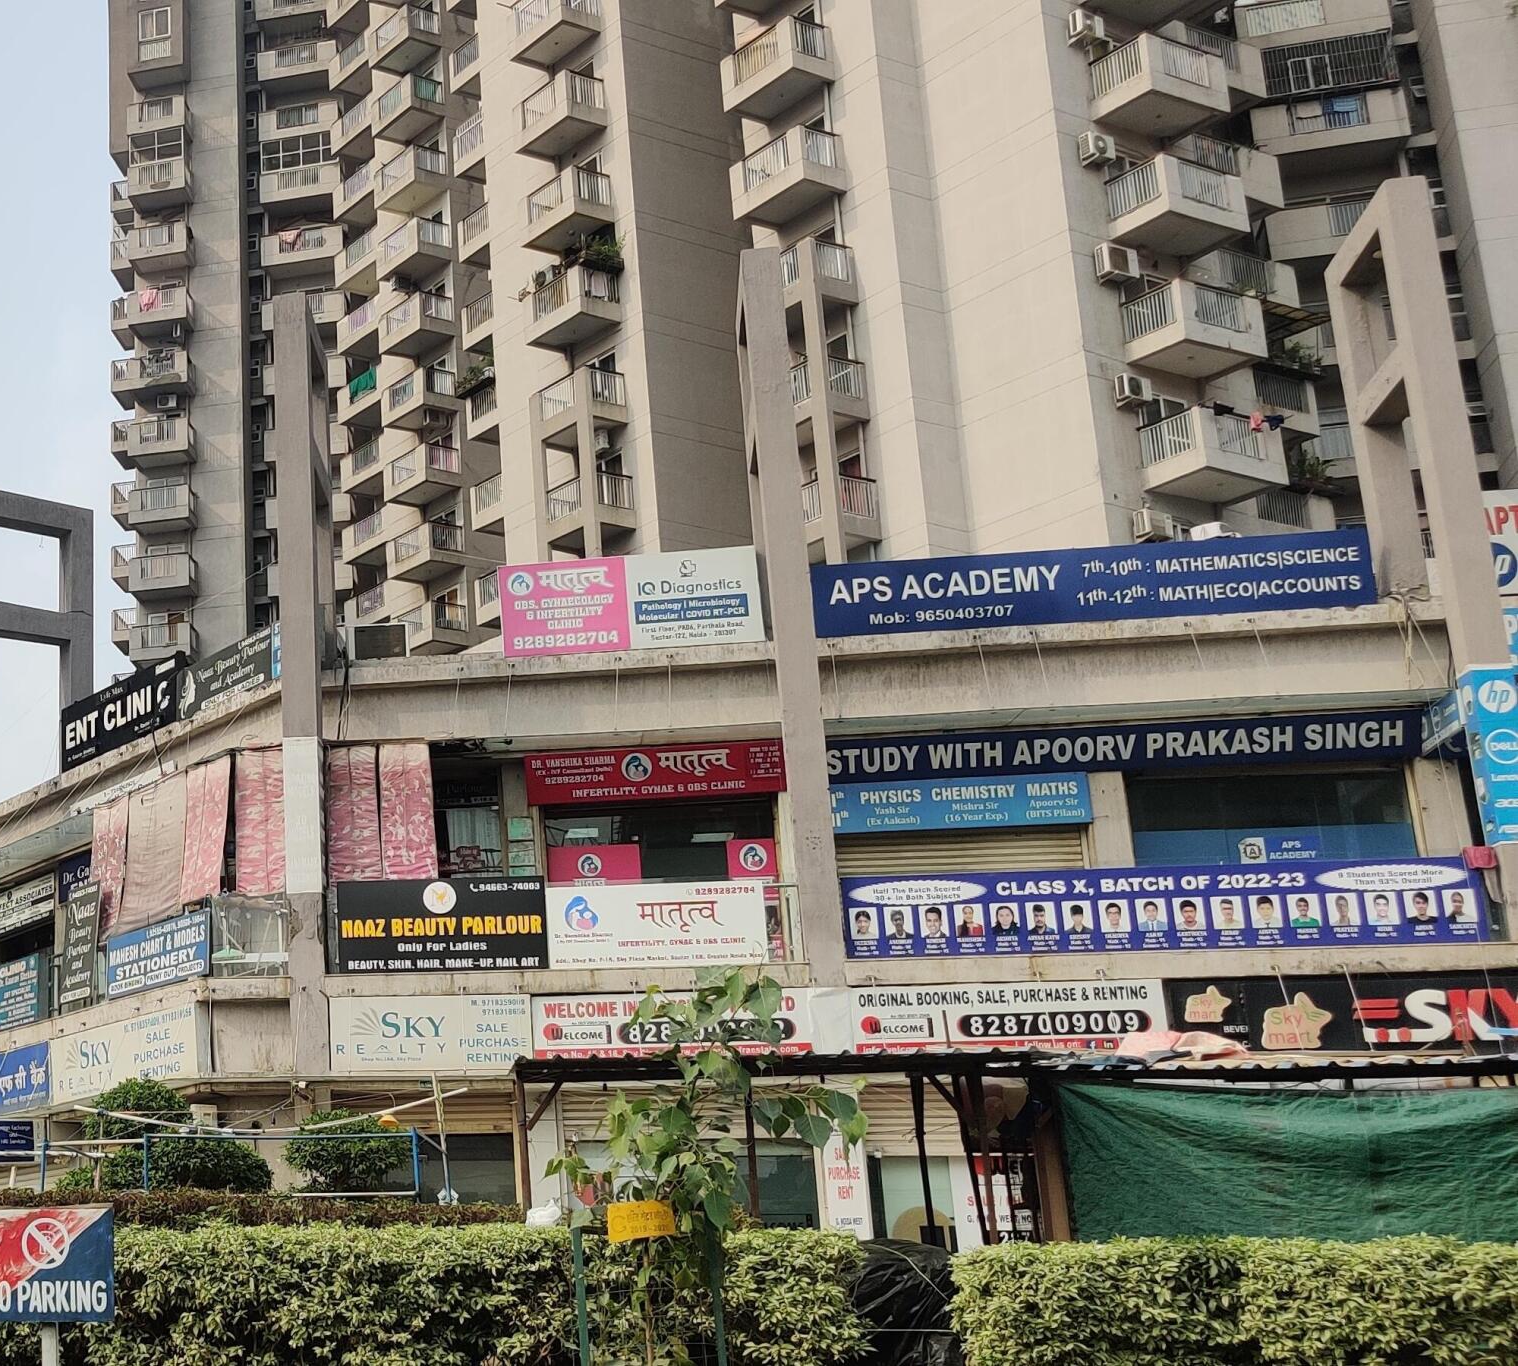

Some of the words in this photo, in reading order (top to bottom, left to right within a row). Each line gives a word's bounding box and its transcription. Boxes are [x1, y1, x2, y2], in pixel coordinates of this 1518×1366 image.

[638, 582, 656, 596] IQ
[661, 579, 742, 594] Diagnostics
[830, 575, 892, 605] APS
[901, 565, 1060, 600] ACADEMY
[642, 603, 682, 611] Pathology
[689, 598, 740, 608] Microbiology
[639, 613, 679, 621] Molecular
[686, 609, 711, 618] COVID
[713, 607, 745, 616] RT-PCR
[869, 612, 910, 625] Mob:
[916, 605, 1014, 622] 9650403707
[514, 630, 619, 649] 9289282704
[66, 710, 98, 750] ENT
[827, 745, 919, 775] STUDY
[928, 741, 1002, 769] WITH
[1013, 734, 1136, 766] APOORV
[1146, 726, 1293, 759] PRAKASH
[1304, 720, 1403, 751] SINGH
[656, 748, 737, 776] मातृत्व
[545, 775, 604, 784] 9289282704
[642, 784, 674, 794] GYNAE
[688, 782, 708, 791] OBS
[710, 780, 746, 790] CLINIC
[860, 789, 922, 804] PHYSICS
[931, 784, 1016, 801] CHEMISTRY
[1026, 781, 1078, 797] MATHS
[962, 812, 982, 821] Year
[1282, 841, 1301, 849] APS
[1270, 850, 1316, 860] ACADEMY
[695, 886, 755, 895] 9289282704
[996, 879, 1067, 896] CLASS
[1072, 879, 1094, 896] X,
[1100, 876, 1174, 894] BATCH
[1181, 876, 1210, 890] OF
[1217, 873, 1305, 889] 2022-23
[14, 884, 53, 905] ASSOCIATES
[636, 900, 724, 932] मातृत्व
[341, 919, 386, 939] NAAZ
[391, 917, 456, 938] BEAUTY
[462, 915, 542, 936] PARLOUR
[109, 944, 139, 968] MAHESH
[140, 936, 164, 958] CHART
[166, 934, 172, 950] &
[173, 924, 205, 949] MODELS
[397, 943, 423, 953] Only
[427, 942, 446, 951] For
[450, 941, 487, 951] Ladies
[115, 945, 197, 980] STATIONERY
[496, 957, 518, 967] NAIL
[521, 957, 539, 966] ART
[858, 991, 913, 1008] ORIGINAL
[916, 990, 974, 1008] BOOKING,
[977, 989, 1010, 1007] SALE,
[1013, 987, 1077, 1003] PURCHASE
[1081, 987, 1090, 1001] &
[1093, 985, 1148, 1001] RENTING
[1192, 997, 1211, 1010] Sky
[543, 1001, 618, 1019] WELCOME
[1189, 1010, 1218, 1021] mart
[381, 1012, 445, 1039] SKY
[476, 1023, 509, 1033] SALE
[969, 1011, 1140, 1037] 8287009009
[1270, 1013, 1303, 1031] Sky
[146, 1028, 170, 1045] SALE
[459, 1038, 528, 1048] PURCHASE
[551, 1027, 604, 1041] WELCOME
[1268, 1030, 1314, 1046] mart
[80, 1039, 111, 1069] SKY
[133, 1043, 185, 1065] PURCHASE
[837, 1186, 854, 1200] RENT
[17, 1280, 107, 1313] PARKING
